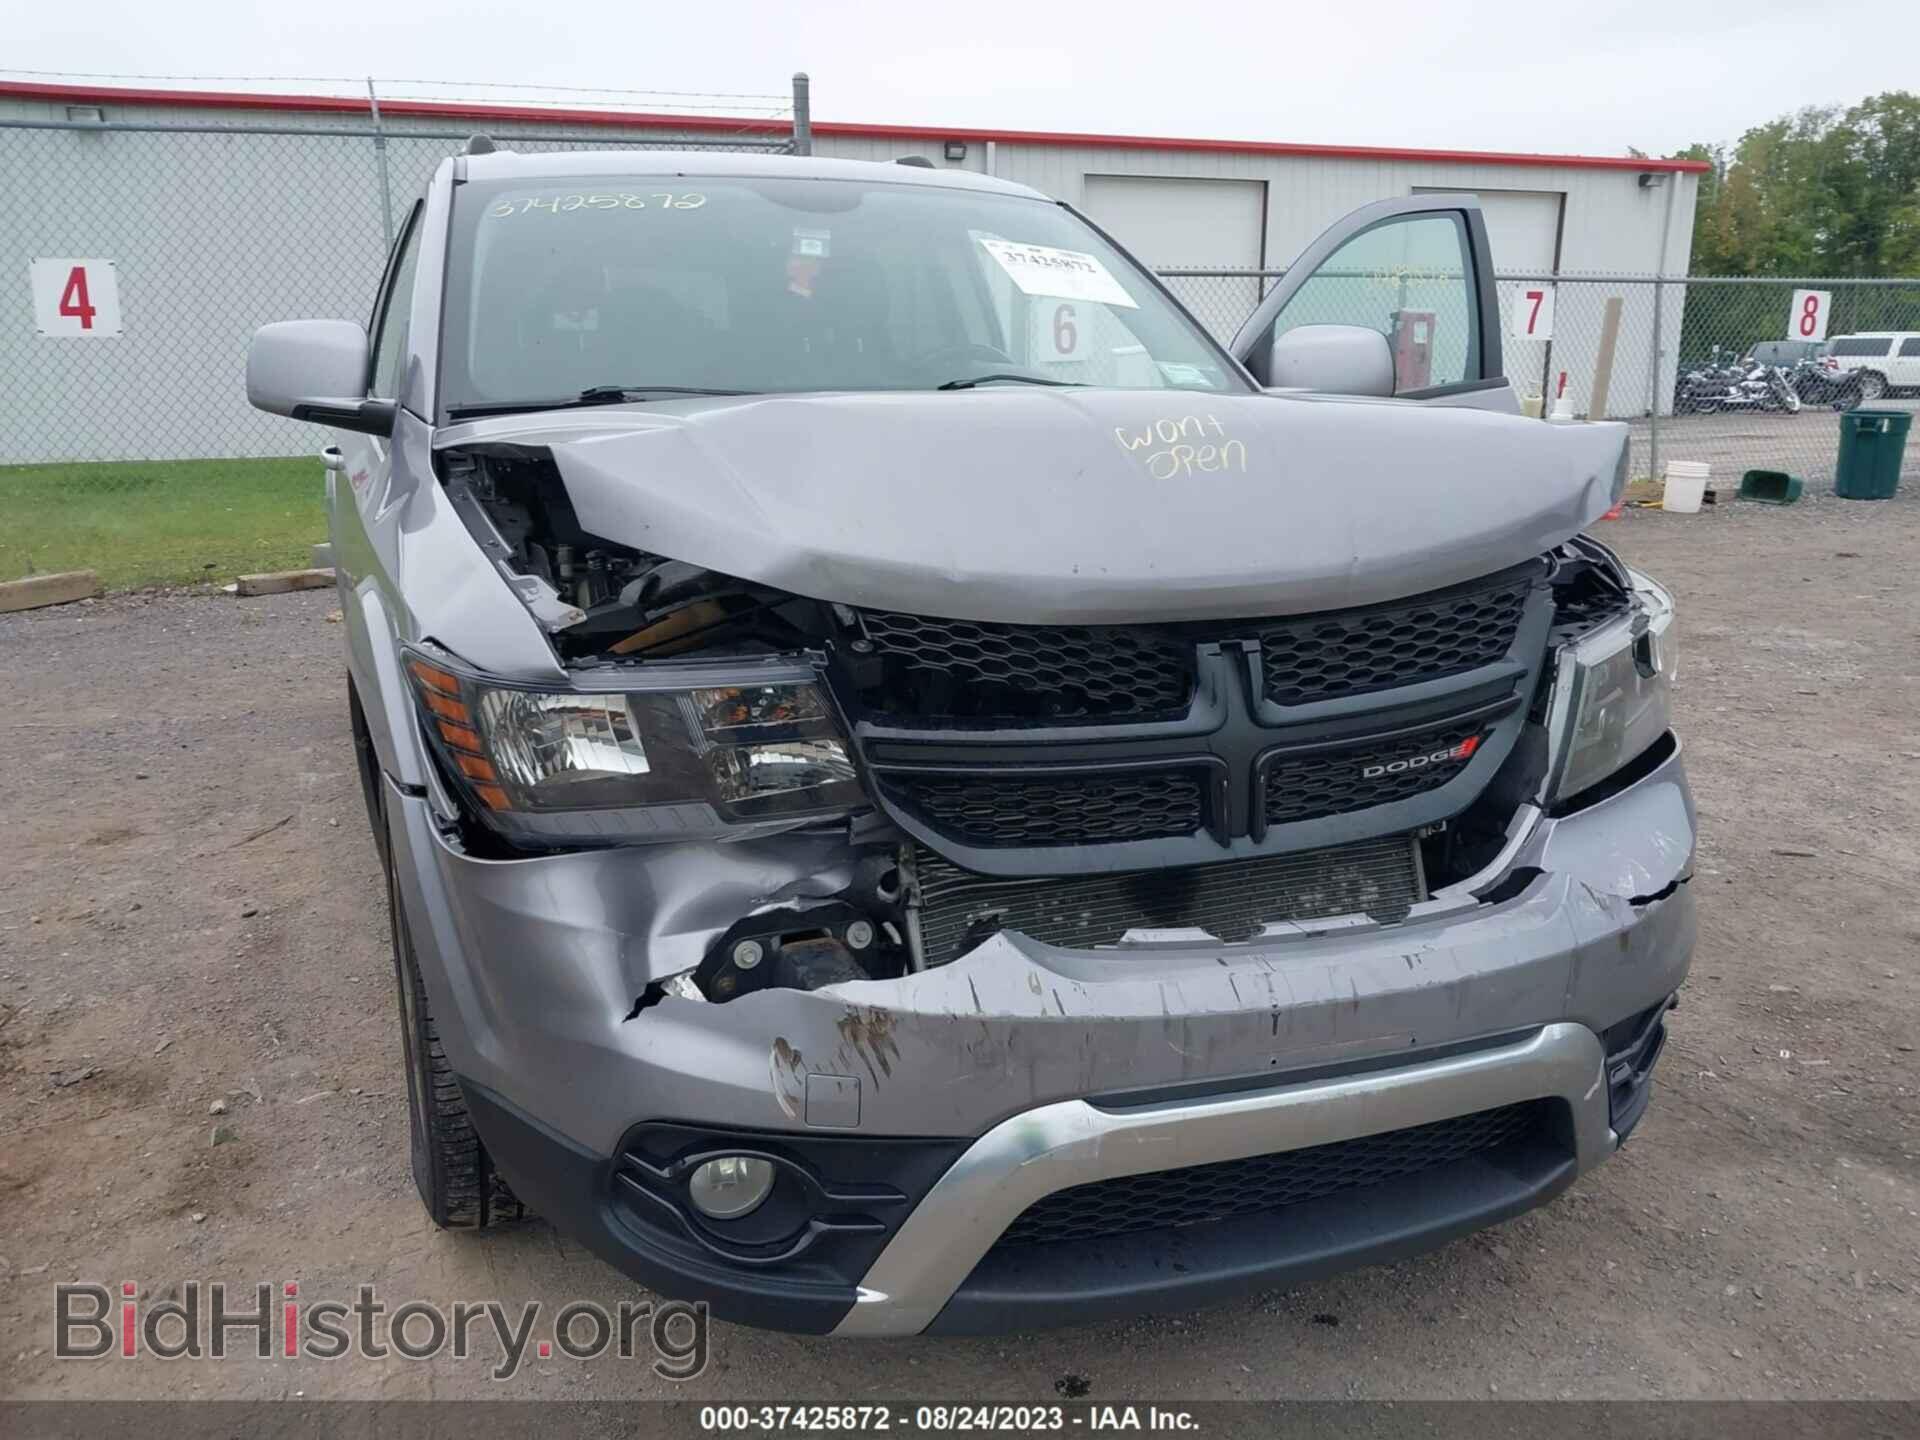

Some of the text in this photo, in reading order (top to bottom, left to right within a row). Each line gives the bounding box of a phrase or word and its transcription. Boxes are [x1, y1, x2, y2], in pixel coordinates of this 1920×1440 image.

[490, 193, 706, 217] 37425872
[59, 266, 96, 329] 4
[1526, 291, 1544, 334] 7
[1800, 295, 1818, 336] 8
[1053, 303, 1078, 355] 6
[1363, 746, 1464, 778] DODGE
